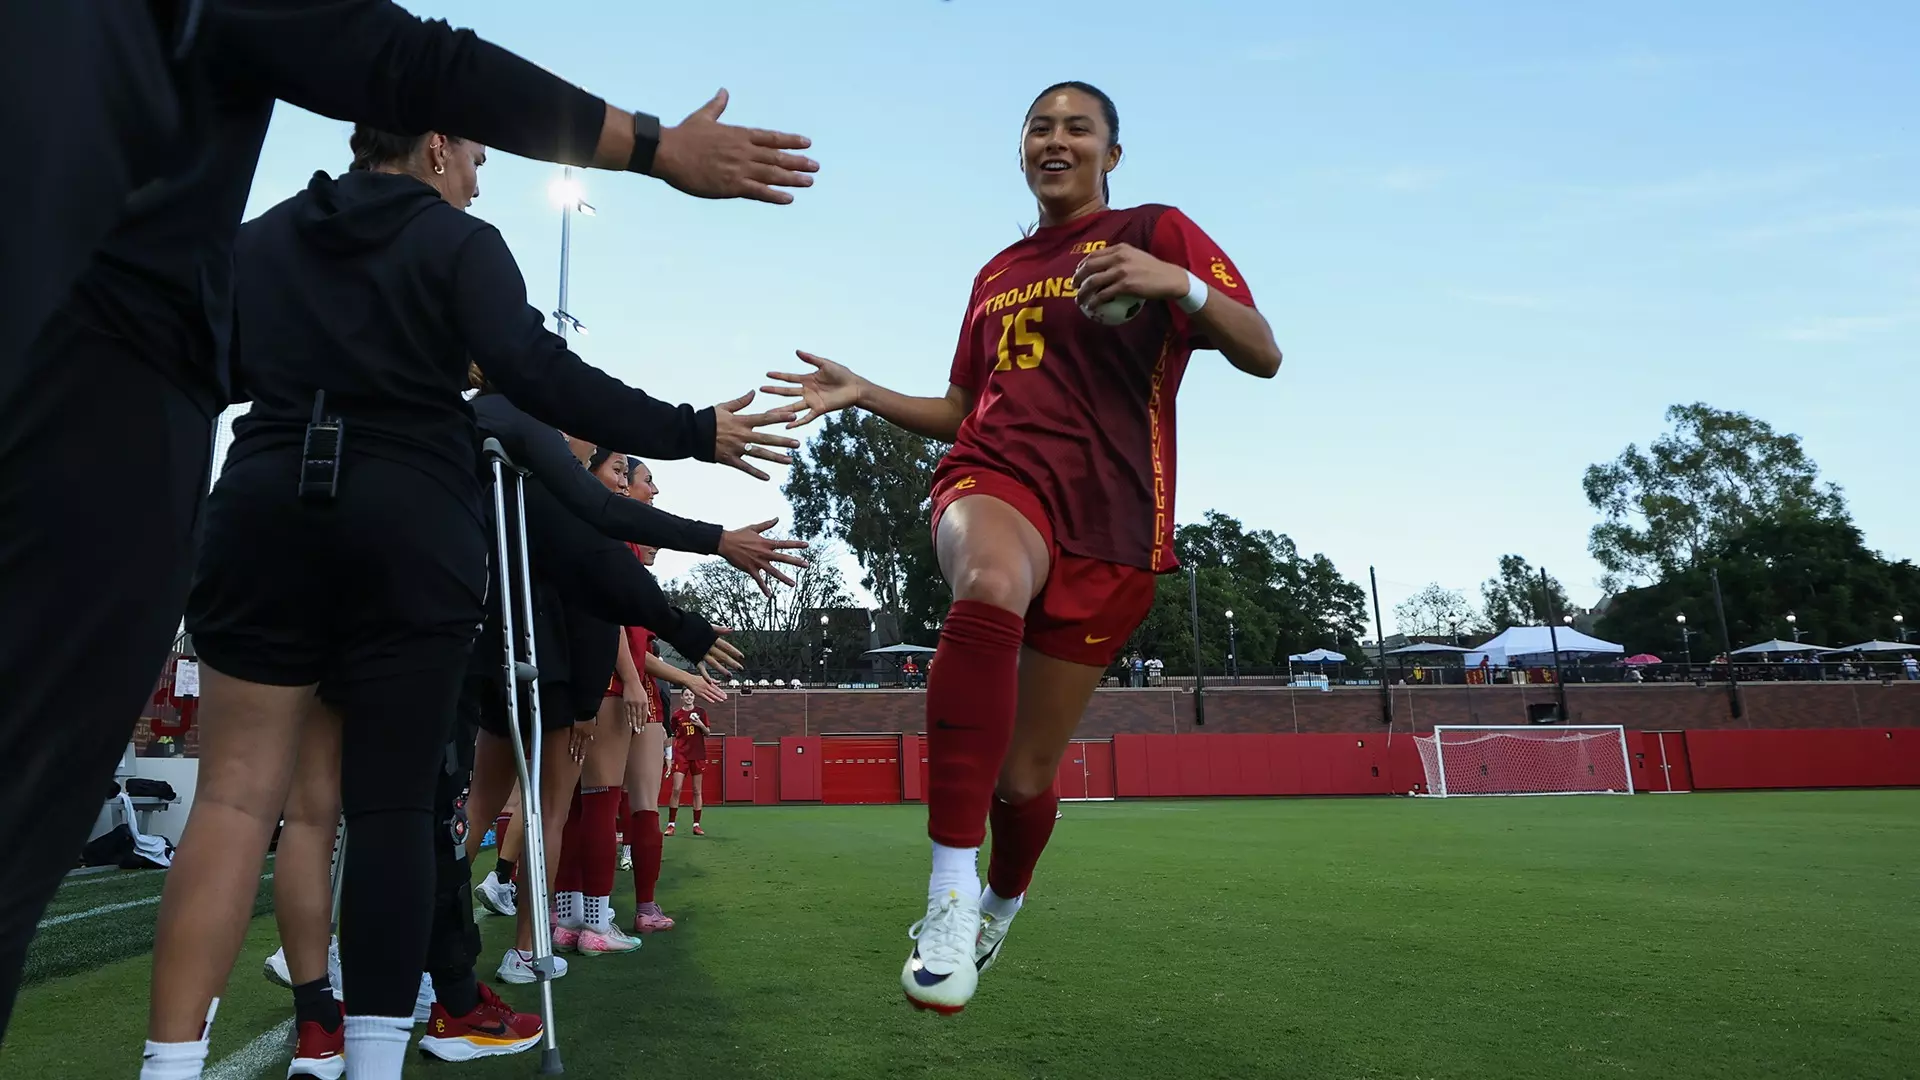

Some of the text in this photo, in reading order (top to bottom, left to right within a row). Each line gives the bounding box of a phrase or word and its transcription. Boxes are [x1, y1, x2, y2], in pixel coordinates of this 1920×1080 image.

[985, 277, 1078, 316] TROJANS
[994, 306, 1045, 372] 15
[686, 725, 694, 735] 18
